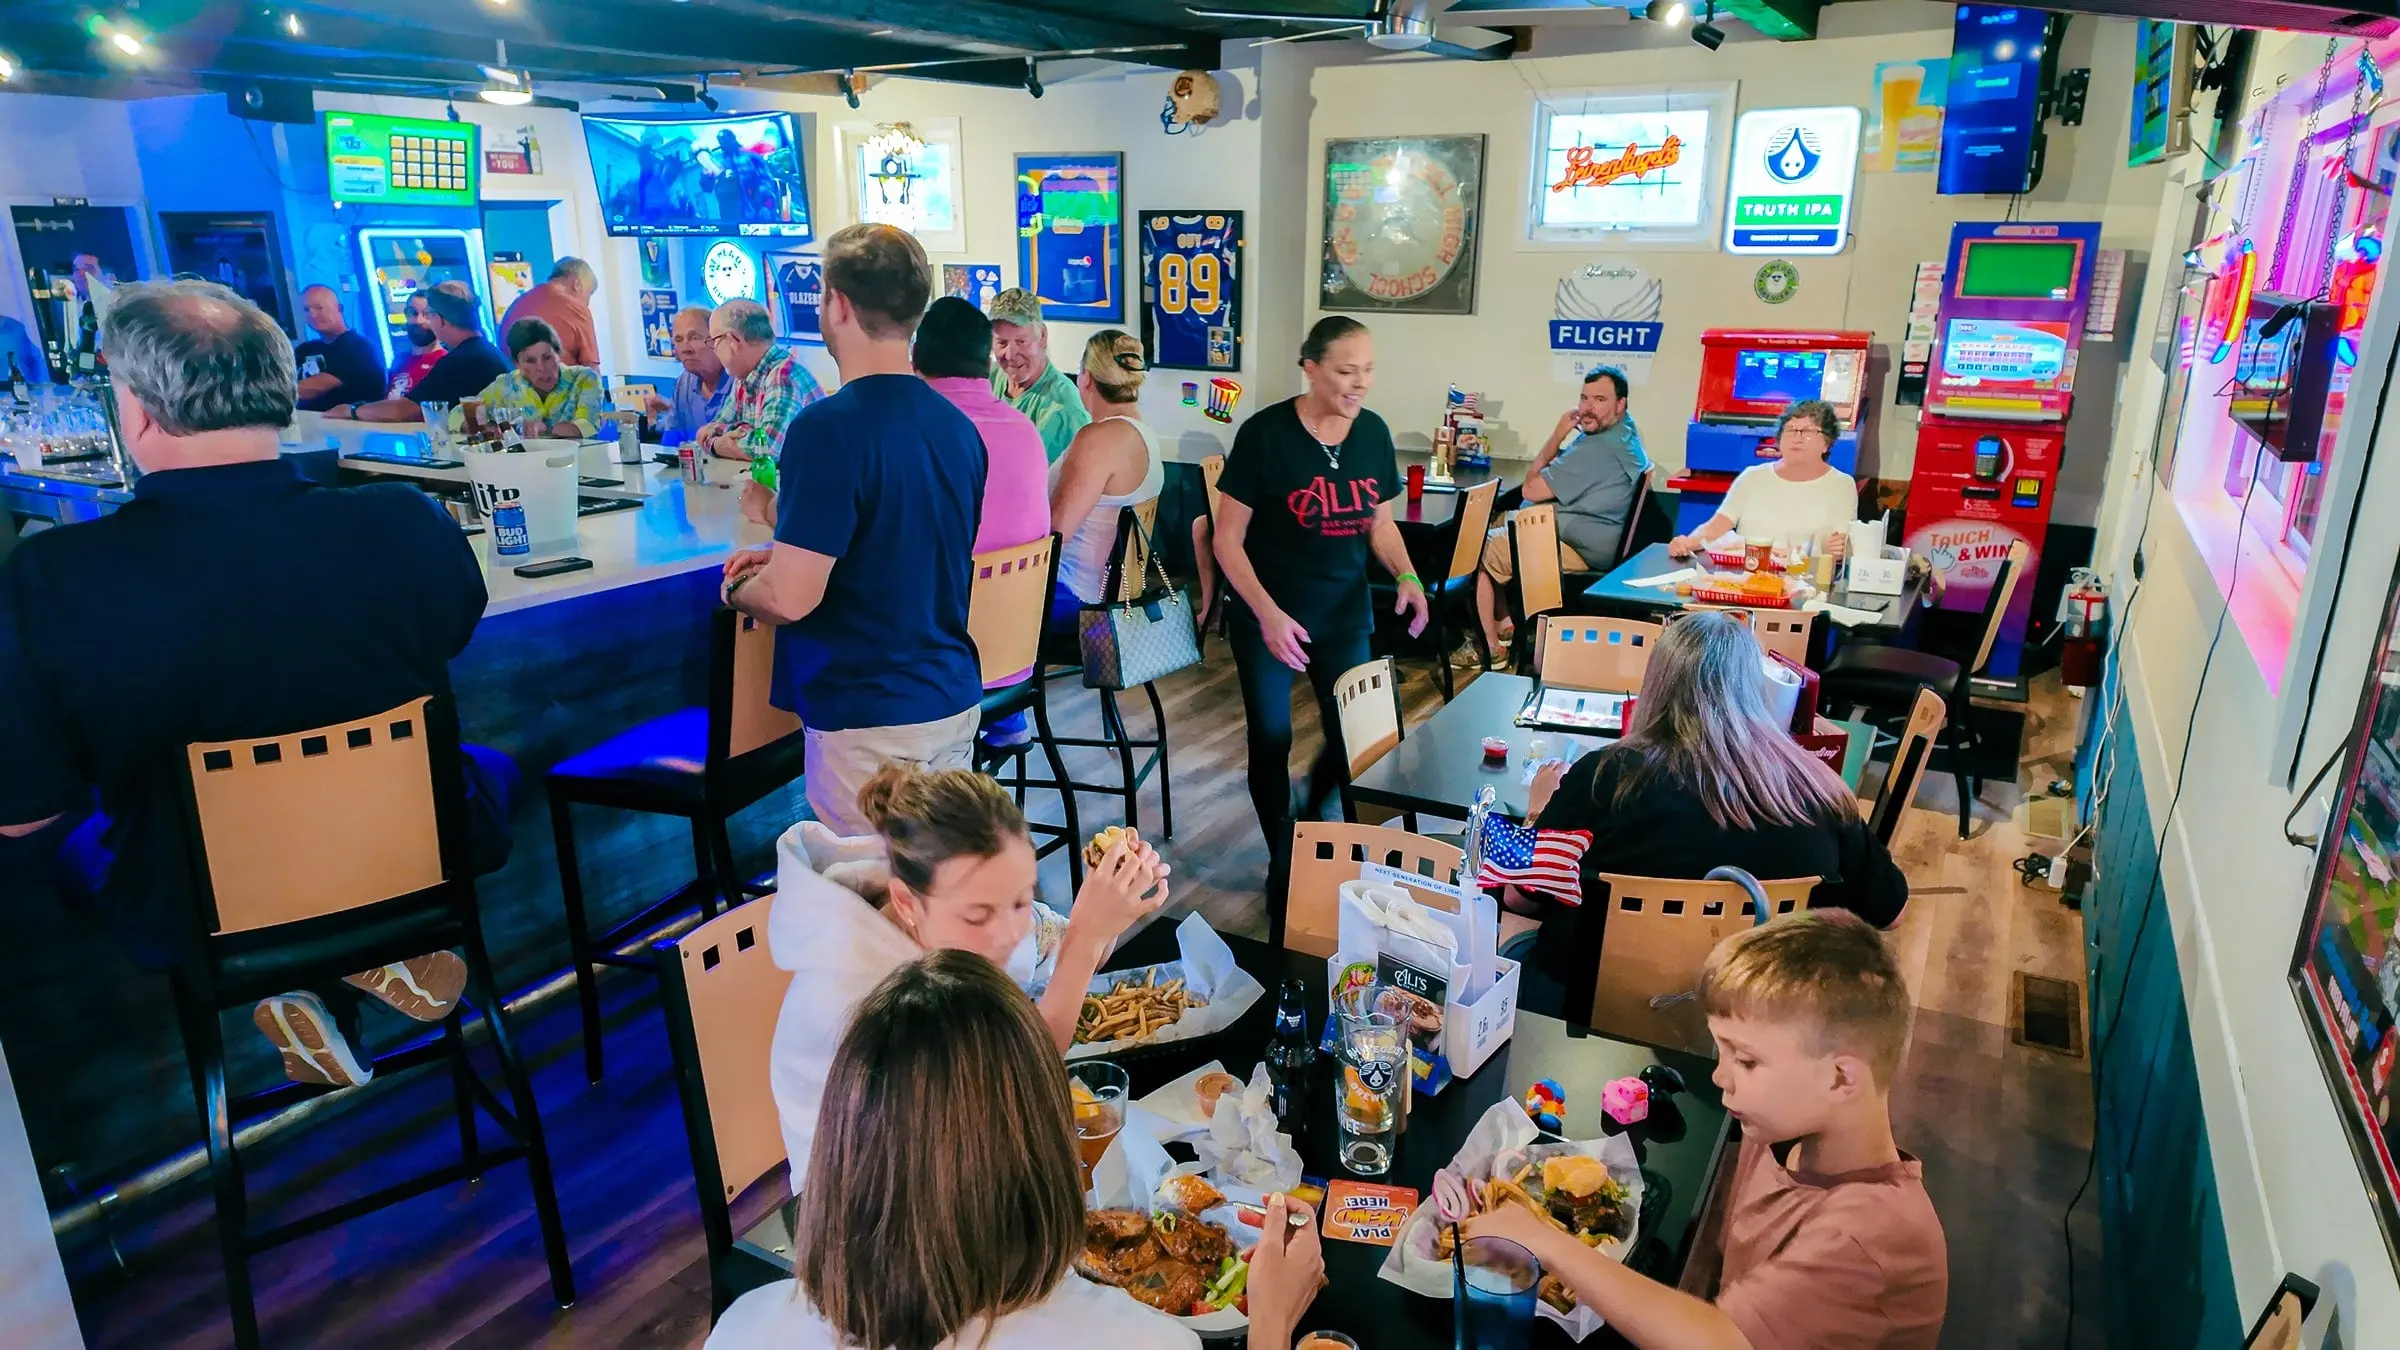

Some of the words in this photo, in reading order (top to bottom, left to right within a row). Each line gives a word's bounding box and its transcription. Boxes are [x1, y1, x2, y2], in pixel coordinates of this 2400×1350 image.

[1744, 203, 1800, 217] TRUTH
[1804, 203, 1833, 216] IPA
[1159, 253, 1221, 315] 89
[1558, 325, 1651, 346] FLIGHT
[1287, 476, 1380, 528] ALI'S
[497, 527, 524, 538] BUD
[497, 535, 529, 547] LIGHT
[1930, 529, 1991, 548] TOUCH
[1958, 548, 1971, 562] &
[1974, 544, 2009, 560] WIN
[1374, 867, 1391, 876] NEXT
[1392, 872, 1432, 889] GENERATION
[1433, 883, 1442, 891] OF
[1394, 968, 1428, 991] ALI'S
[1350, 1081, 1398, 1102] BREWERY
[1345, 1196, 1388, 1207] HERE!
[1334, 1207, 1407, 1229] KENO
[1352, 1227, 1392, 1238] PLAY
